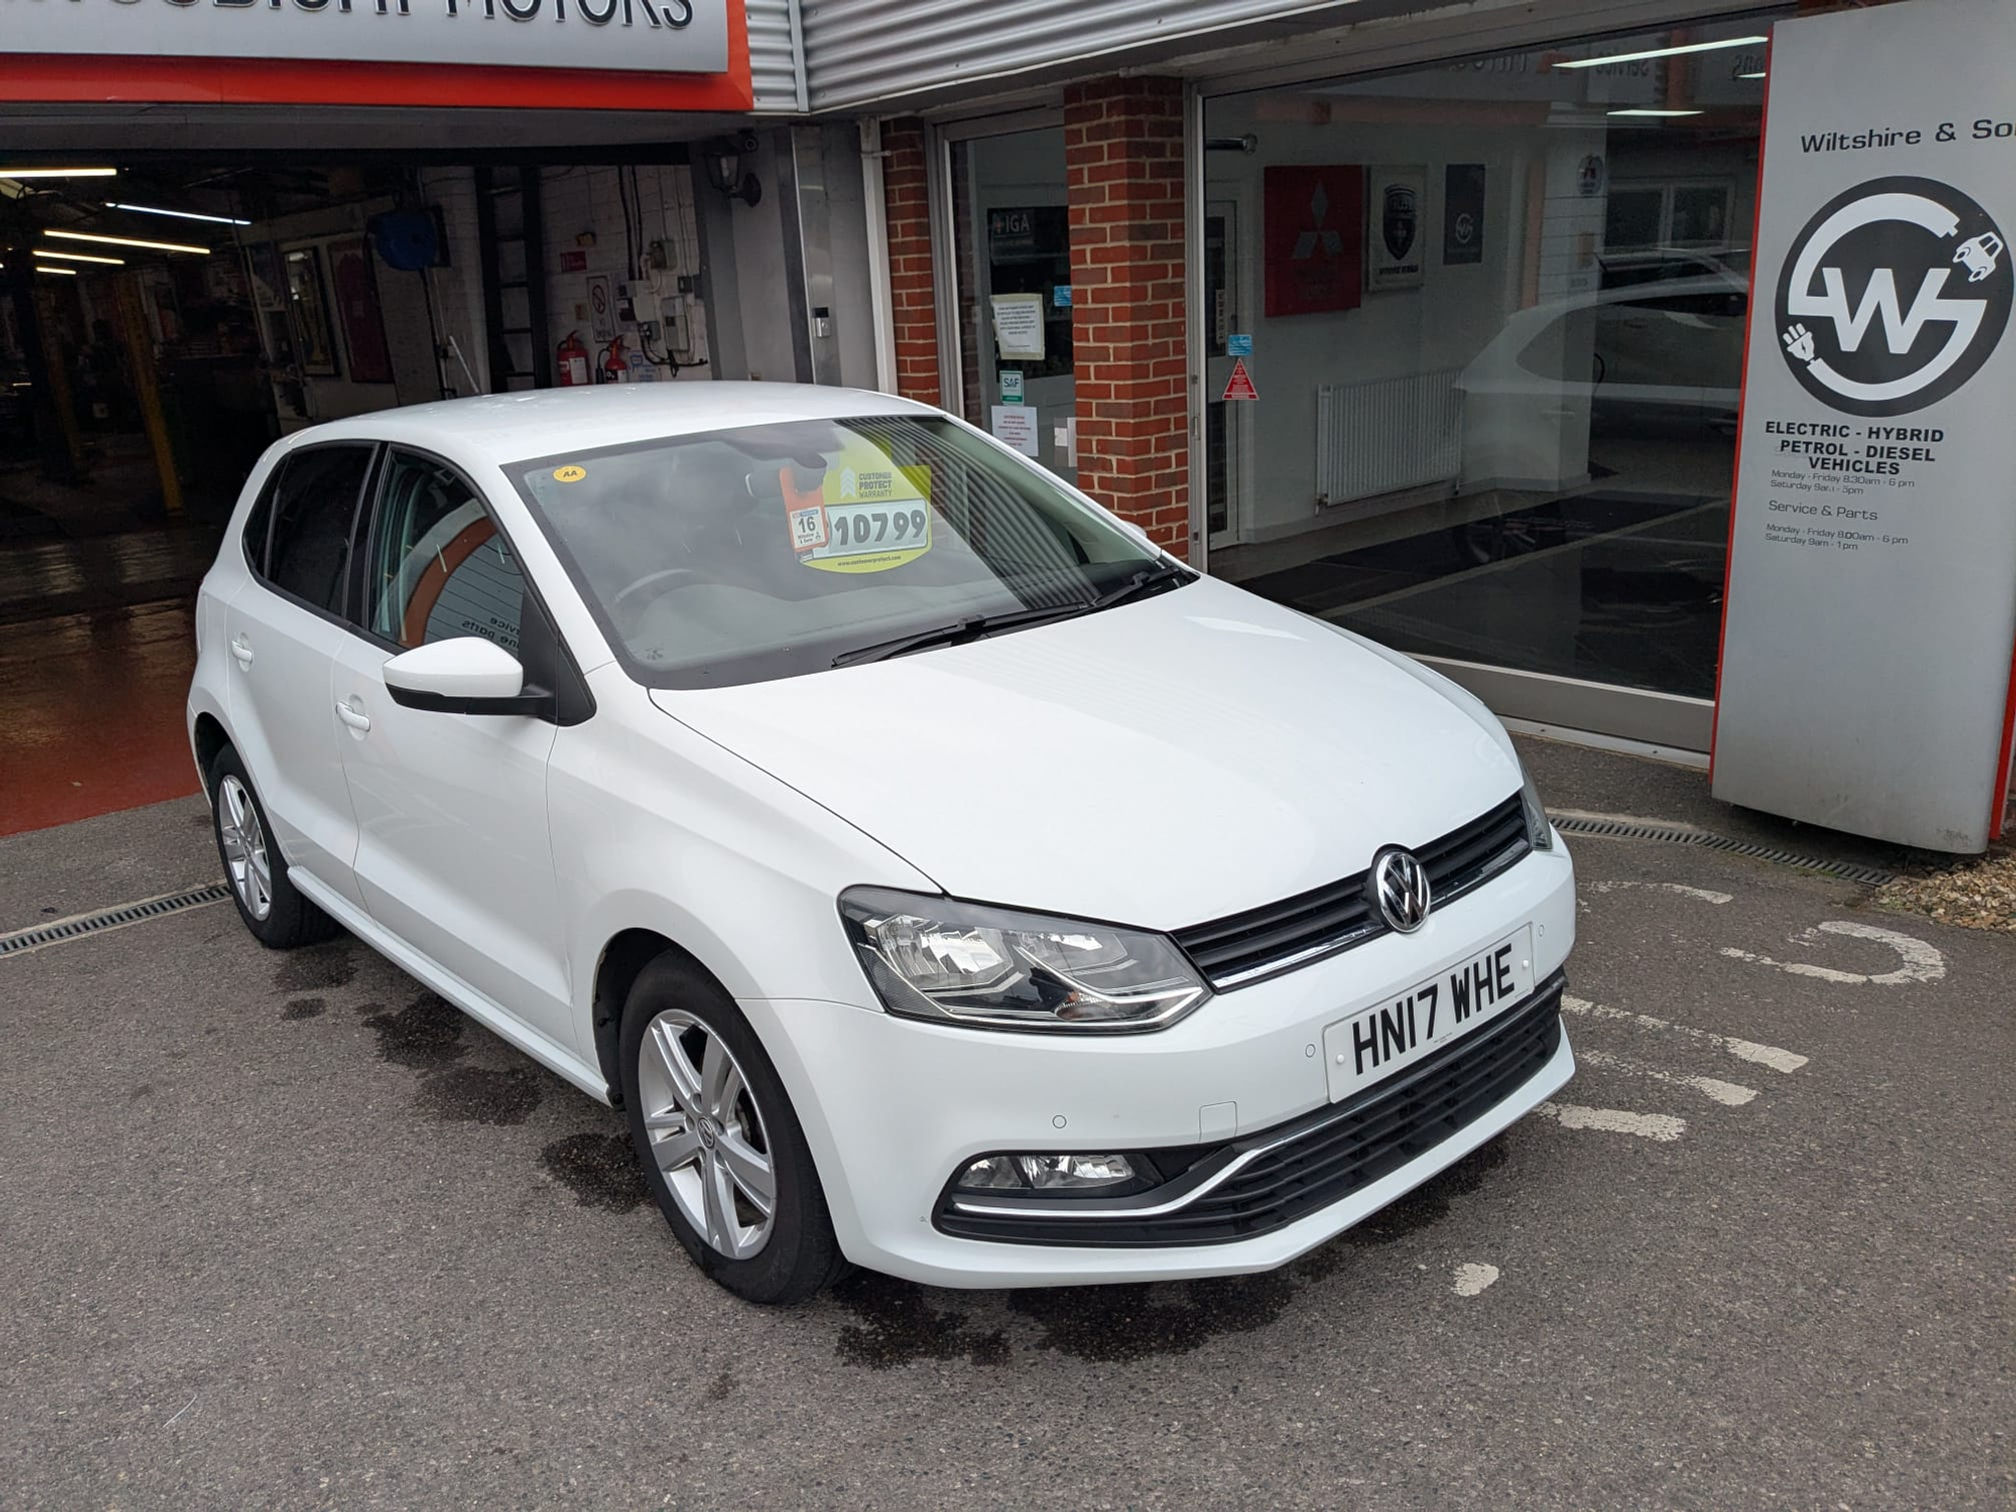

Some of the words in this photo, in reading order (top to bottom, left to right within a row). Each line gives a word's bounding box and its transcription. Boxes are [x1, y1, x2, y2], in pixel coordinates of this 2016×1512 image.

[1801, 127, 1921, 153] Wiltshire
[1936, 122, 1957, 142] &
[1972, 119, 2016, 139] So
[1005, 214, 1030, 233] IGA
[1765, 421, 1850, 438] ELECTRIC
[1867, 426, 1944, 442] HYBRID
[1780, 440, 1848, 456] PETROL
[1866, 445, 1936, 462] DIESEL
[1808, 456, 1900, 475] VEHICLES
[858, 480, 893, 490] PROTECT
[1770, 479, 1811, 492] Saturday
[1771, 469, 1806, 480] Monday
[1812, 472, 1841, 484] Friday
[1888, 477, 1897, 486] 6
[1898, 480, 1915, 488] pm
[859, 489, 893, 497] WARRANTY
[1768, 500, 1818, 515] Service
[1821, 505, 1833, 516] &
[1837, 506, 1878, 521] Parts
[798, 516, 816, 533] 16
[834, 509, 926, 546] 10799
[1766, 523, 1801, 535] Monday
[1807, 528, 1835, 539] Friday
[1882, 534, 1890, 543] 6
[1891, 536, 1909, 545] pm
[1765, 533, 1807, 546] Saturday
[1808, 537, 1829, 547] 9am
[1352, 983, 1439, 1076] HN17
[1450, 943, 1515, 1024] WHE
